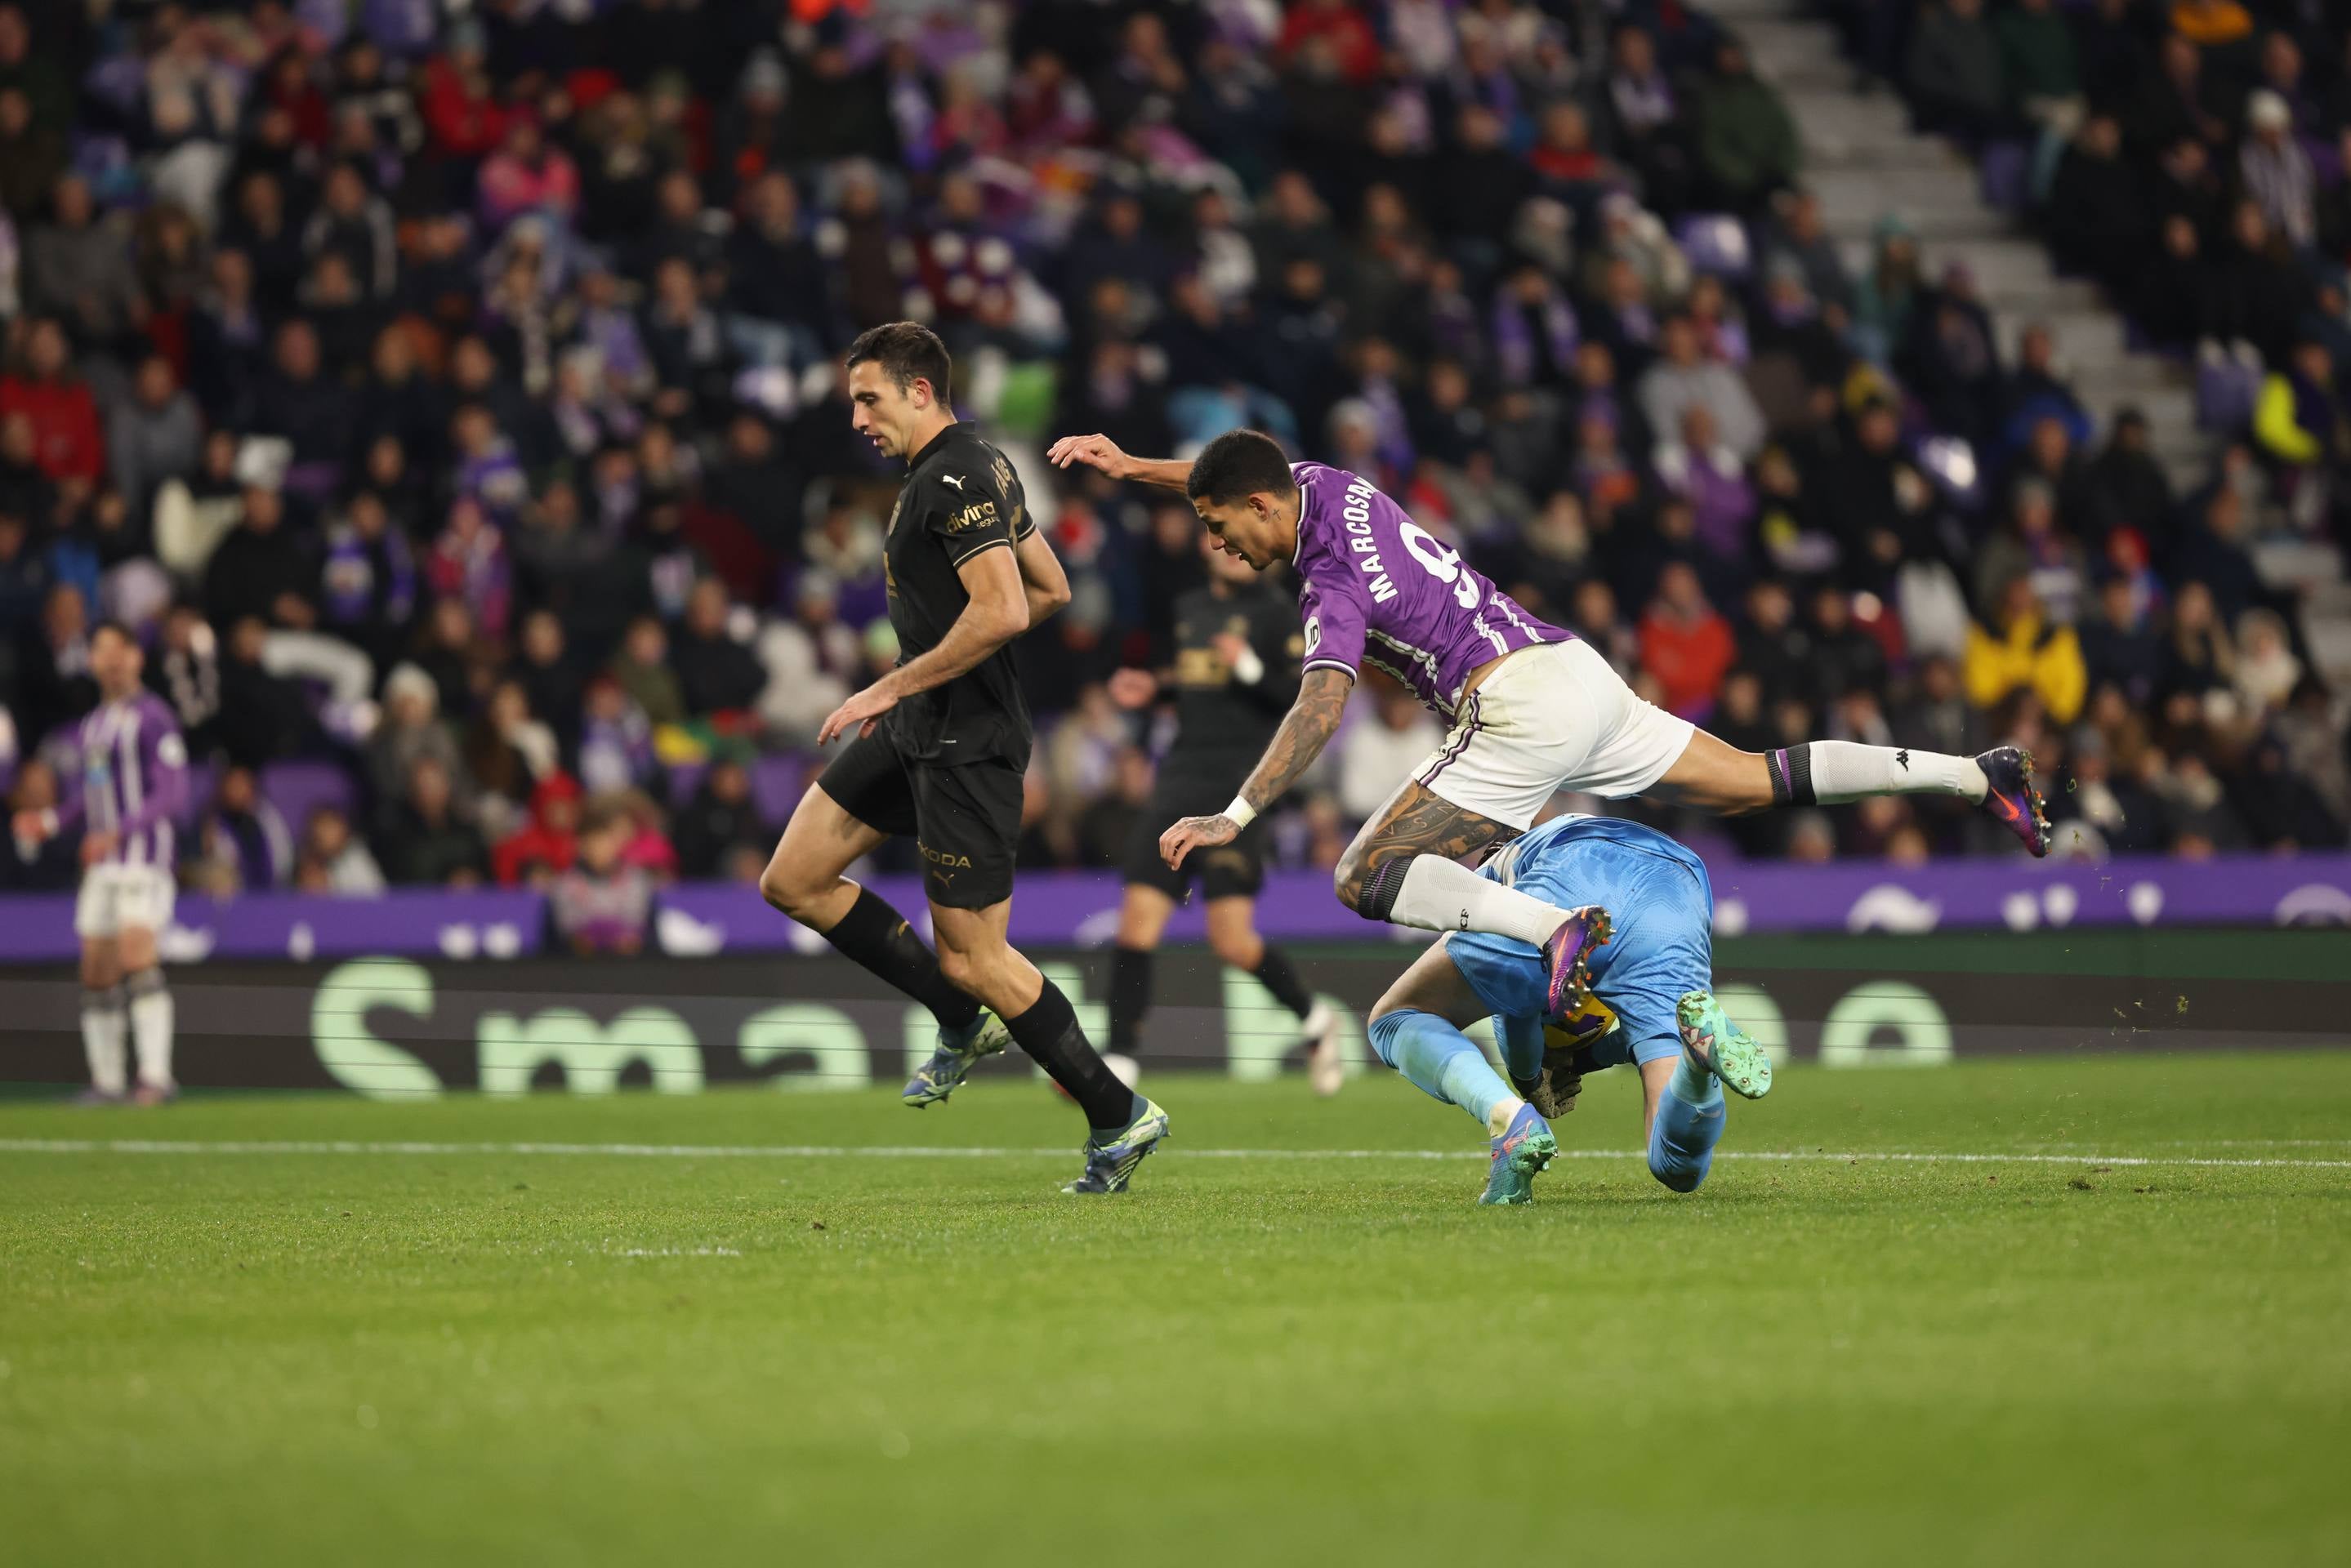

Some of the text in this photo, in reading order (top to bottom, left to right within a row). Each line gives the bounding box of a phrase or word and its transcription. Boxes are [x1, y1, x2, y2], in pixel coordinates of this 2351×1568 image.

[948, 501, 996, 534] divina
[1399, 522, 1480, 609] 9
[1308, 624, 1319, 651] JD
